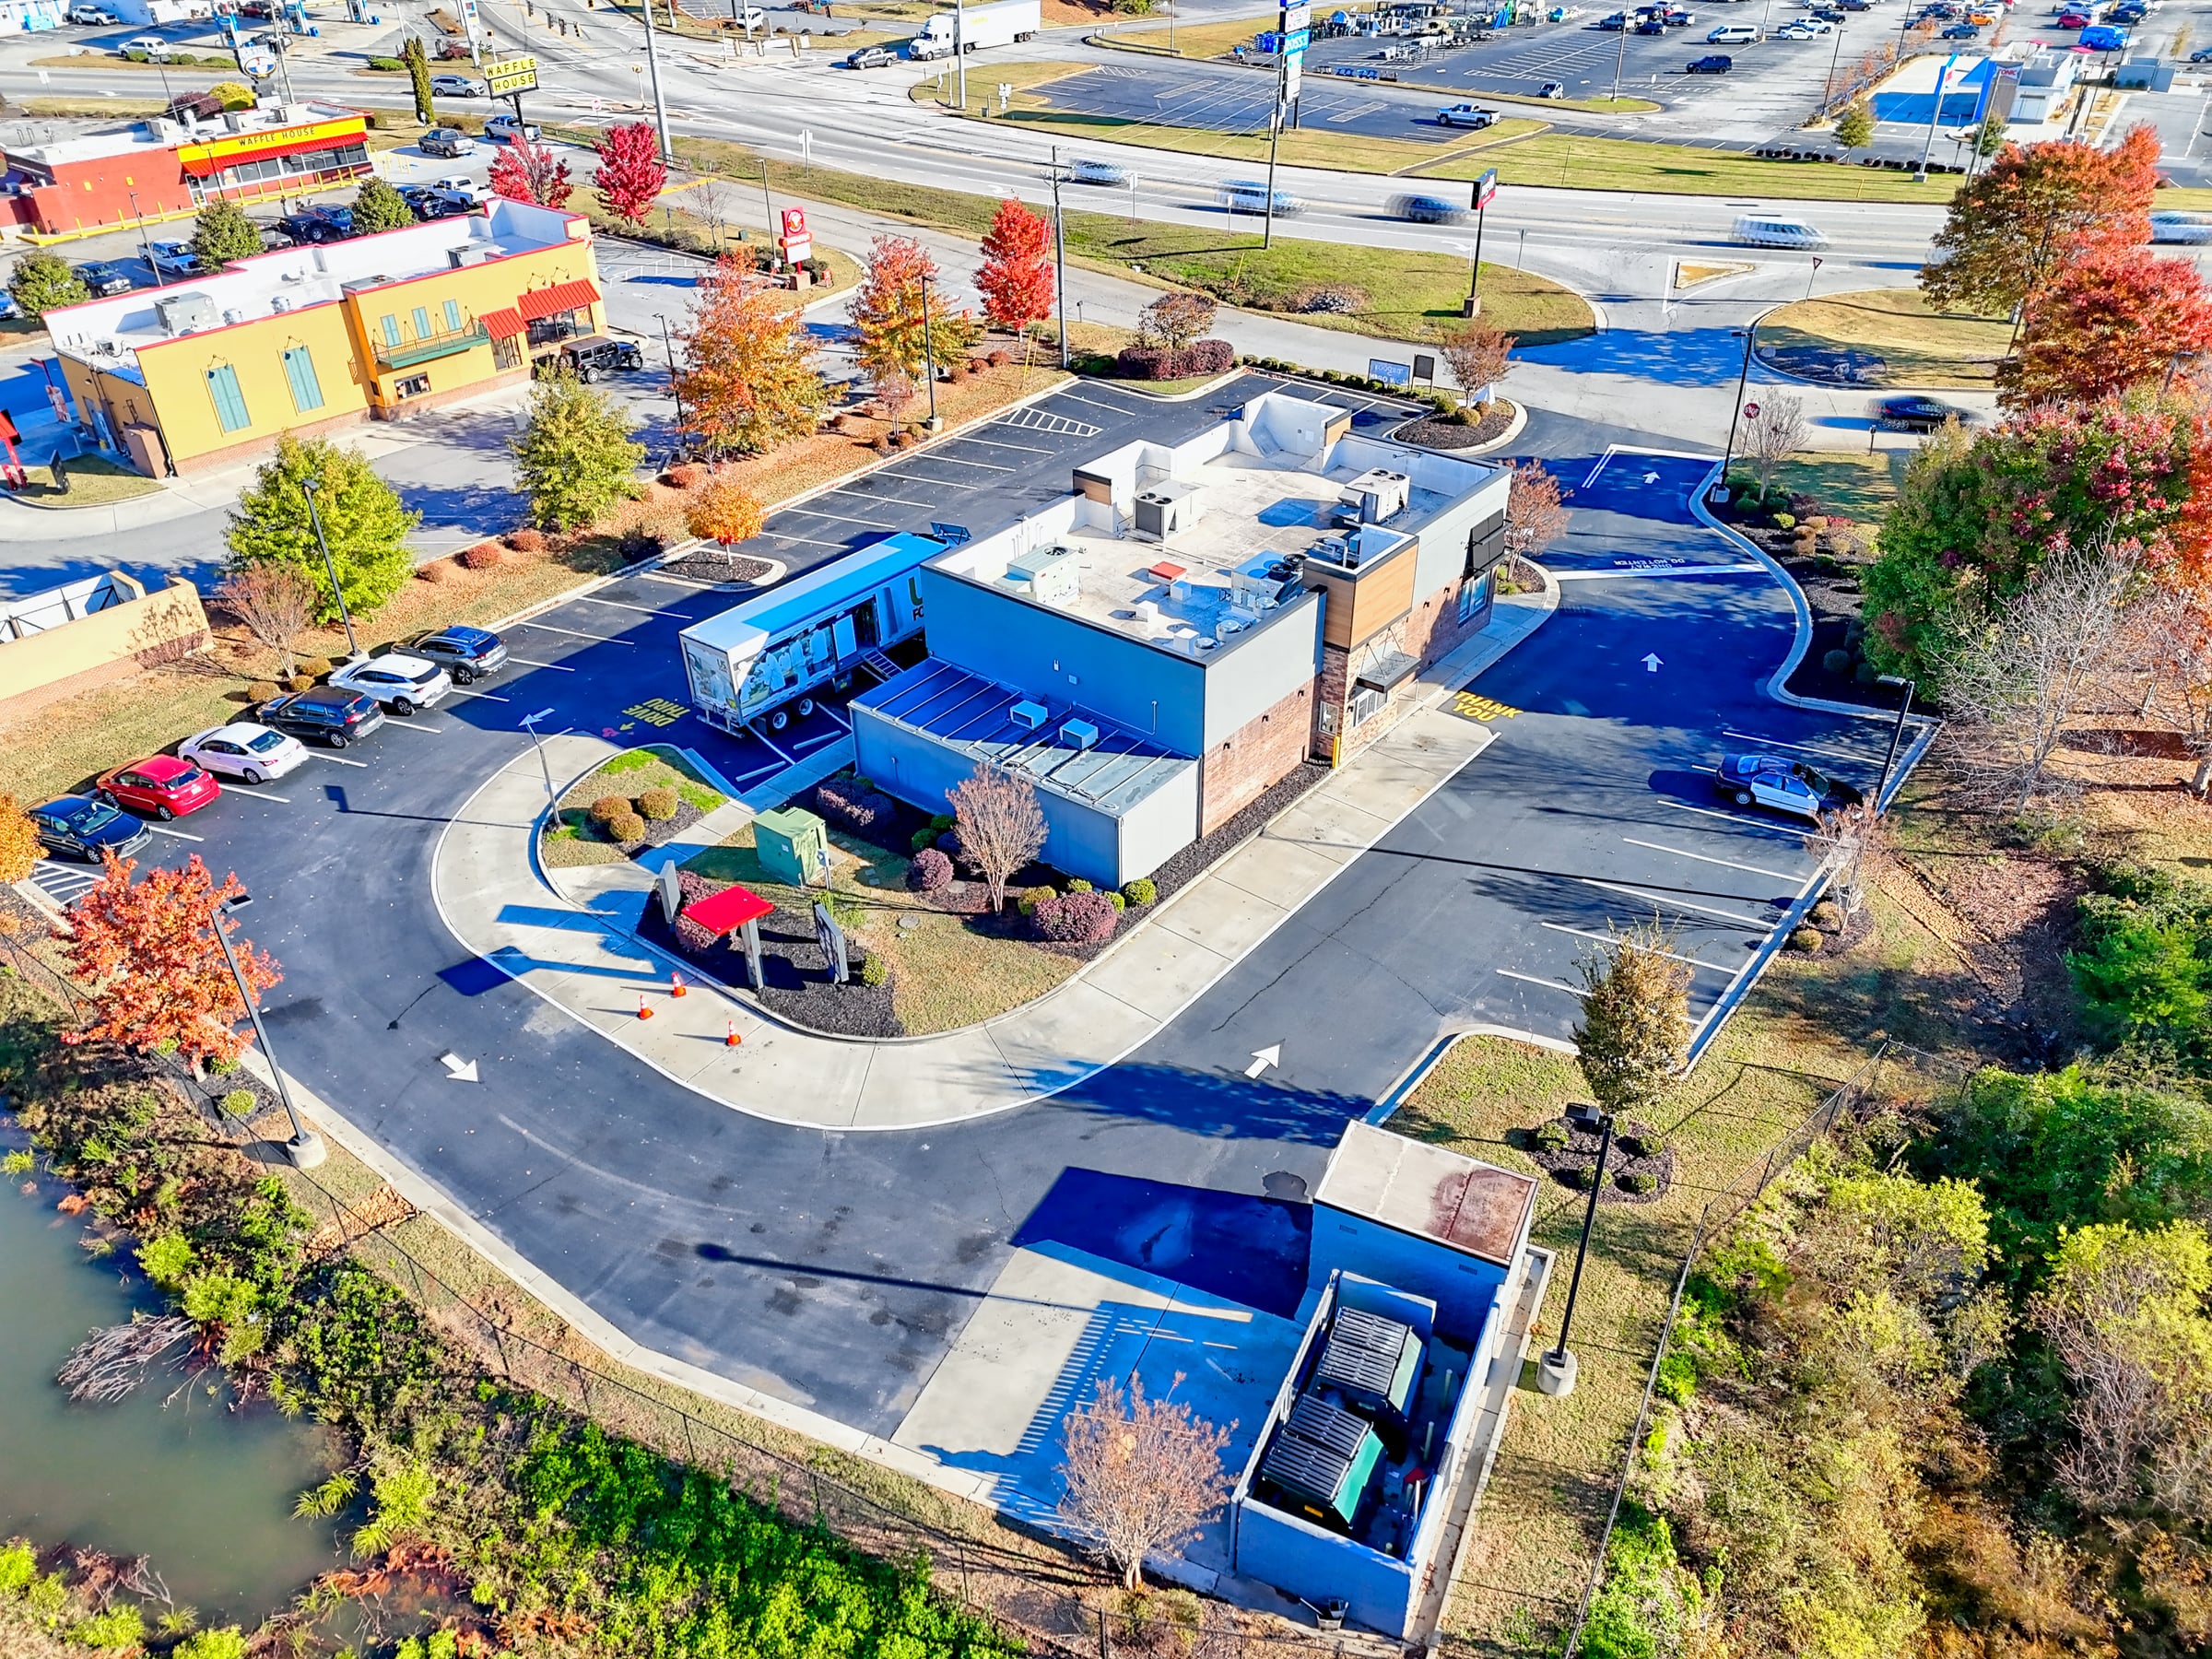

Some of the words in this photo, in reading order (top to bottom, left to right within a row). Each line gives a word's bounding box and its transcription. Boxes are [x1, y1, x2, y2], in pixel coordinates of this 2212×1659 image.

[487, 58, 535, 77] WAFFLE
[494, 74, 535, 91] HOUSE
[239, 133, 276, 147] WAFFLE
[282, 126, 315, 139] HOUSE
[1745, 406, 1759, 416] STOP
[642, 698, 691, 719] THRU
[1453, 690, 1524, 719] THANK
[1453, 701, 1498, 722] YOU
[621, 705, 676, 727] DRIVE
